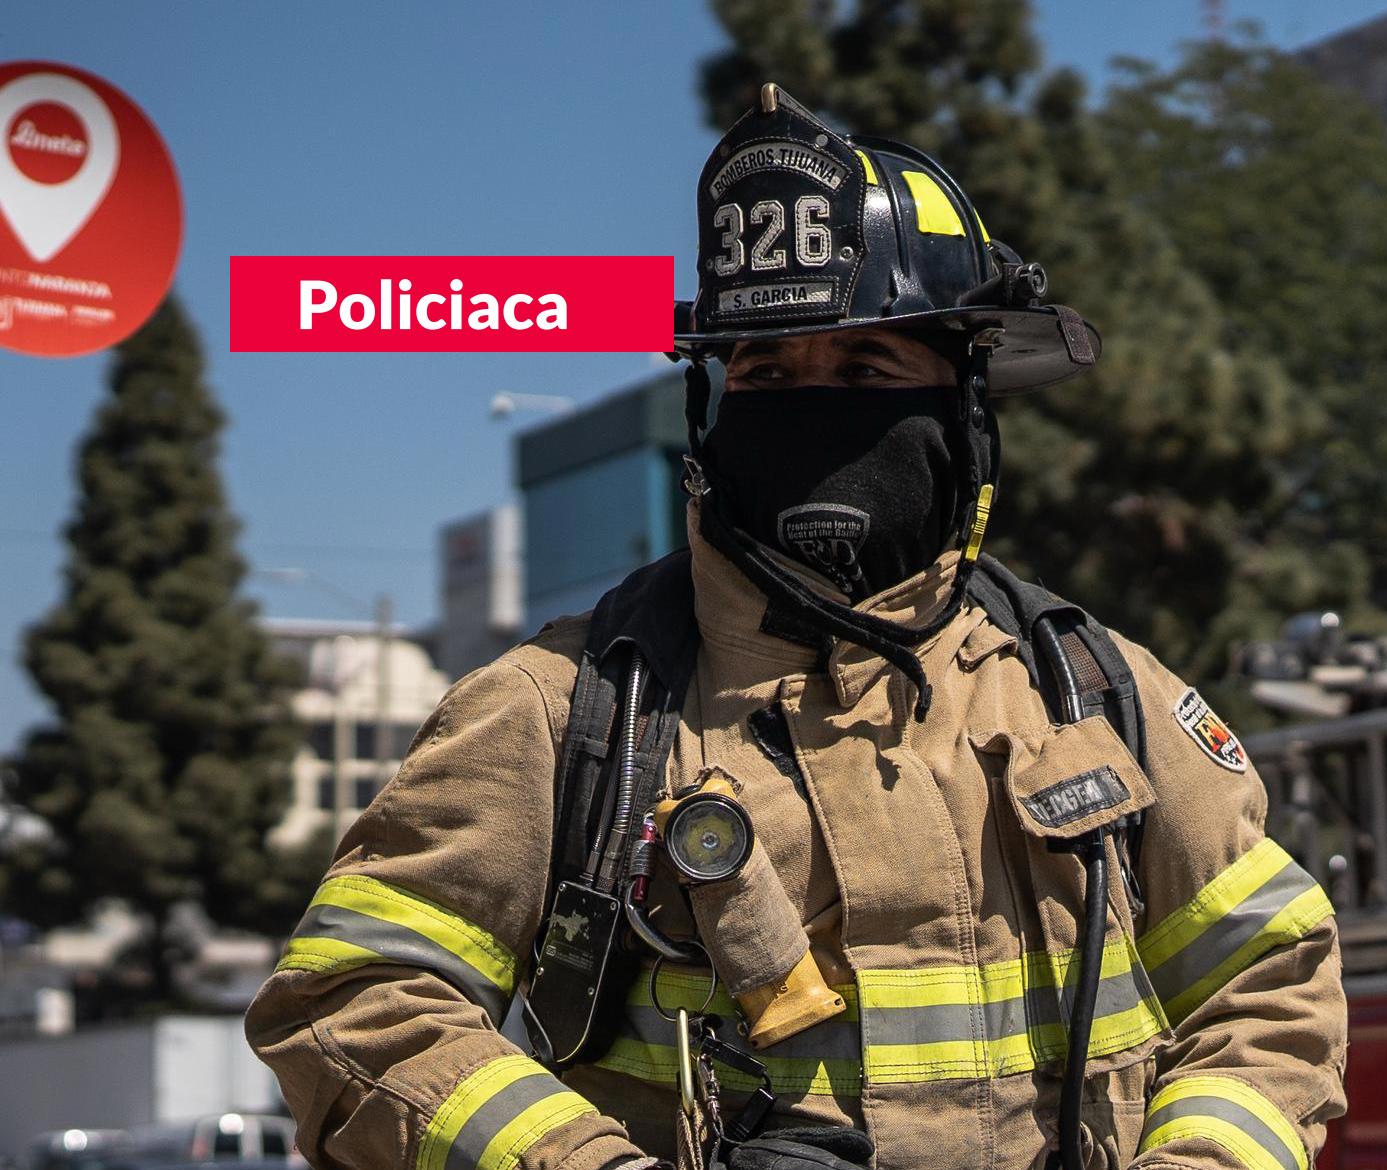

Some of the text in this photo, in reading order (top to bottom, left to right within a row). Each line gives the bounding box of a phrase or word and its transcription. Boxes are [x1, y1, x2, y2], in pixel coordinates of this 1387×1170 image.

[714, 148, 838, 194] BOMBEROS TIJUANA
[713, 195, 832, 277] 326
[734, 286, 809, 309] S. GARCIA
